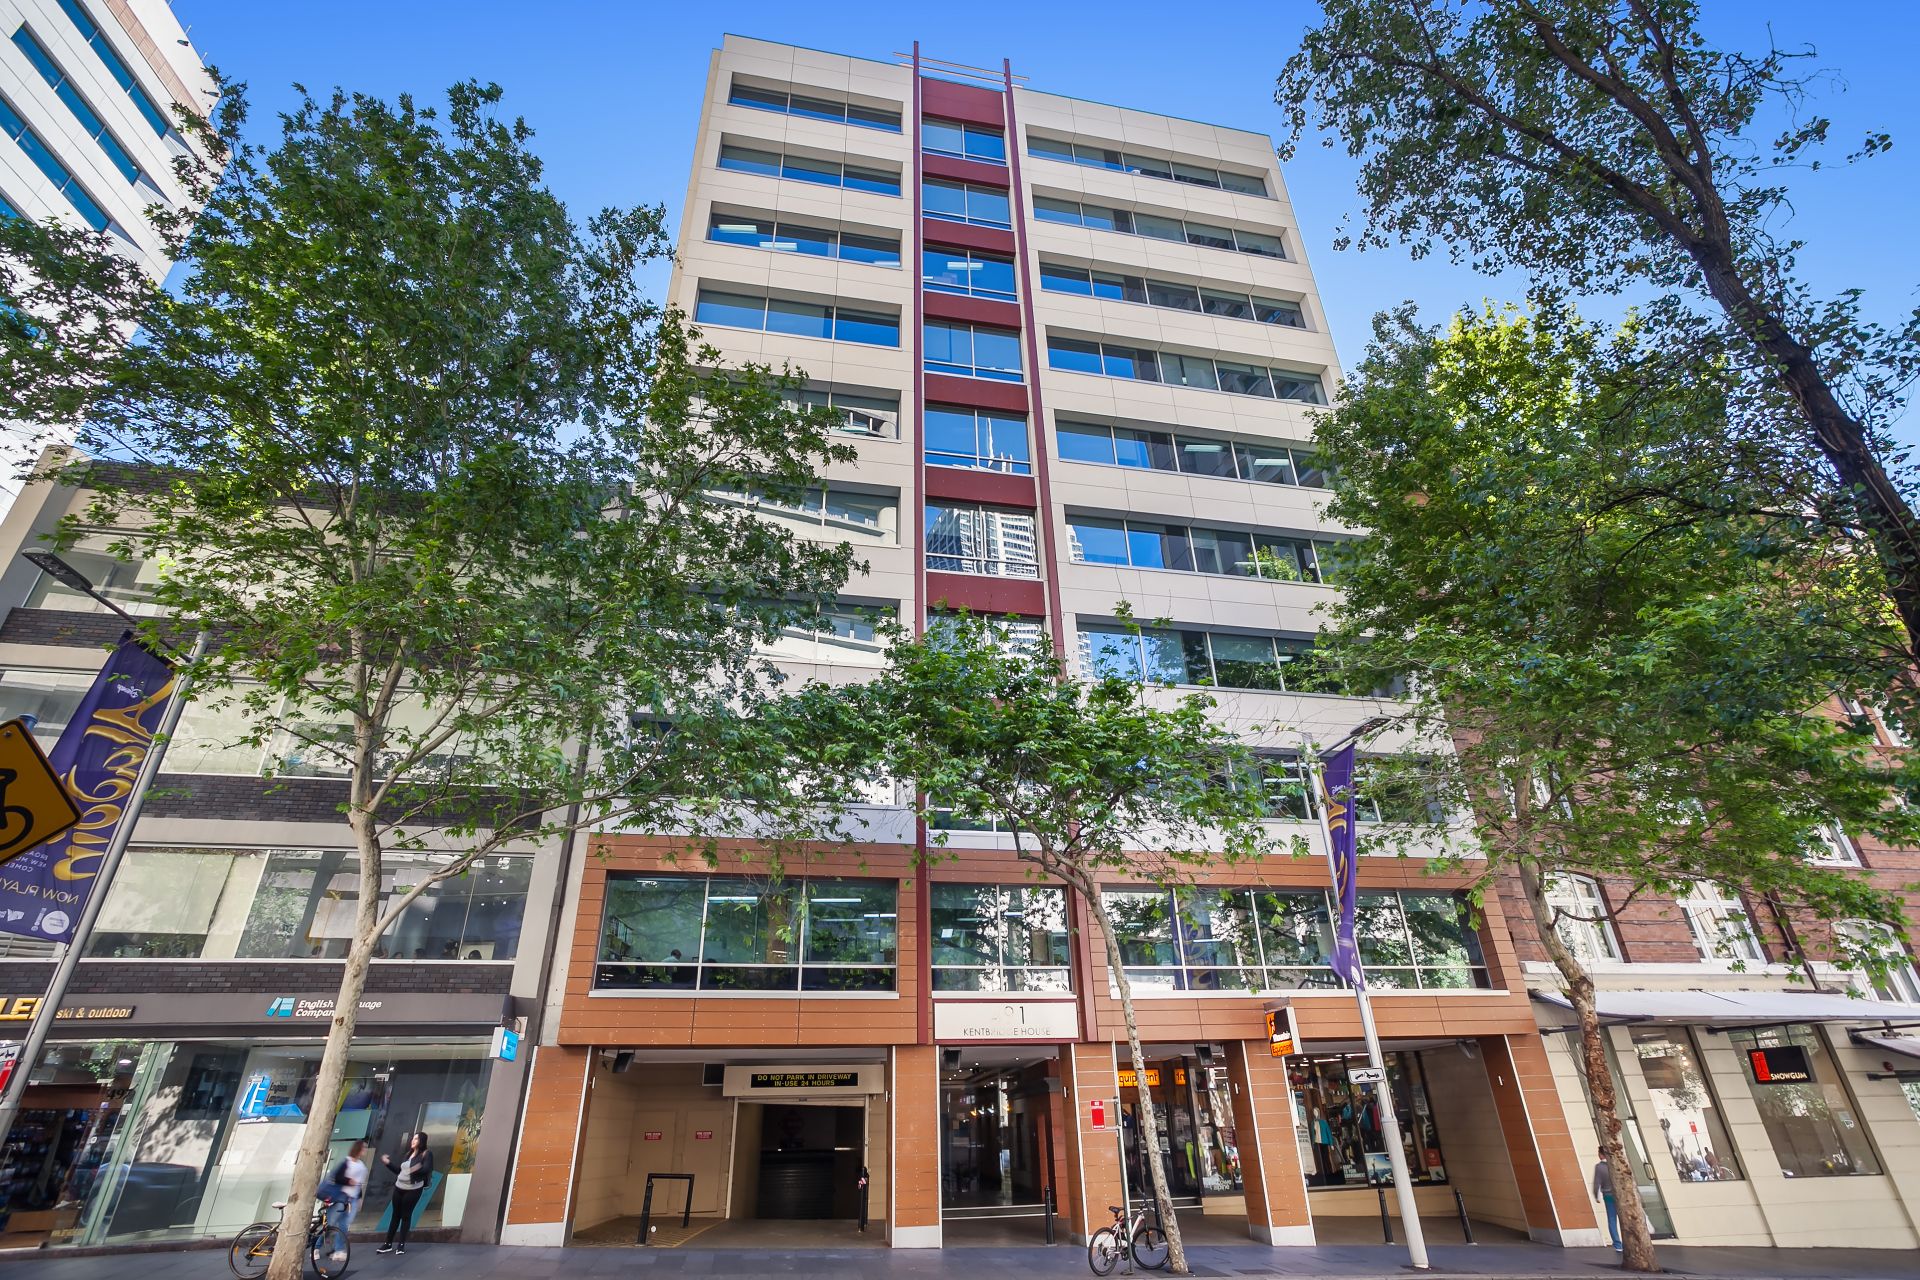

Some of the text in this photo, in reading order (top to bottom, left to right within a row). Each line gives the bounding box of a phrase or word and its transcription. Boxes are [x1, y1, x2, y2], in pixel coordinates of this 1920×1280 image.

[297, 1000, 334, 1010] English
[56, 1007, 132, 1019] ski & outdoor
[295, 1009, 335, 1018] Compan
[1118, 1071, 1159, 1087] quipent
[1770, 1072, 1808, 1080] SNOWGUM
